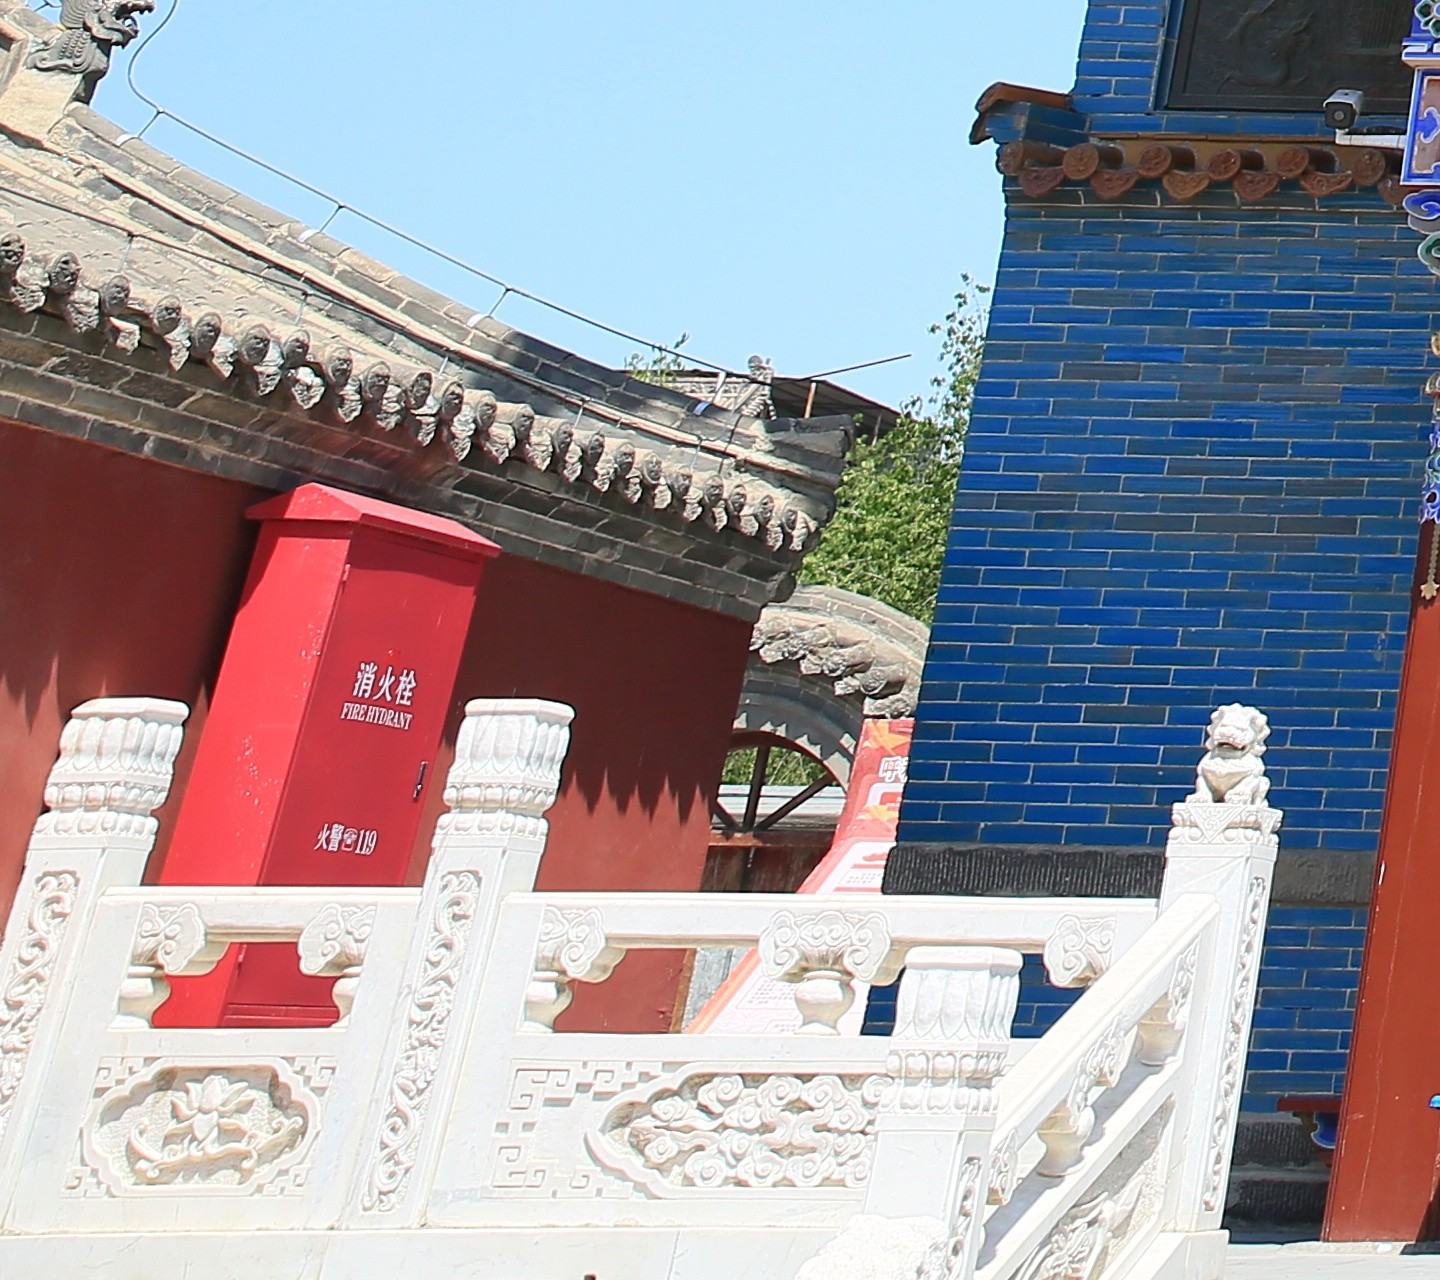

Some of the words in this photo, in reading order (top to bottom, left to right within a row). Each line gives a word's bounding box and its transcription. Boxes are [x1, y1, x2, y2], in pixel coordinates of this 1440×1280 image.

[352, 661, 417, 706] 消火栓
[340, 701, 367, 722] FIRE
[365, 705, 413, 731] HYDRANT
[315, 822, 345, 851] 火警
[354, 828, 378, 856] 119
